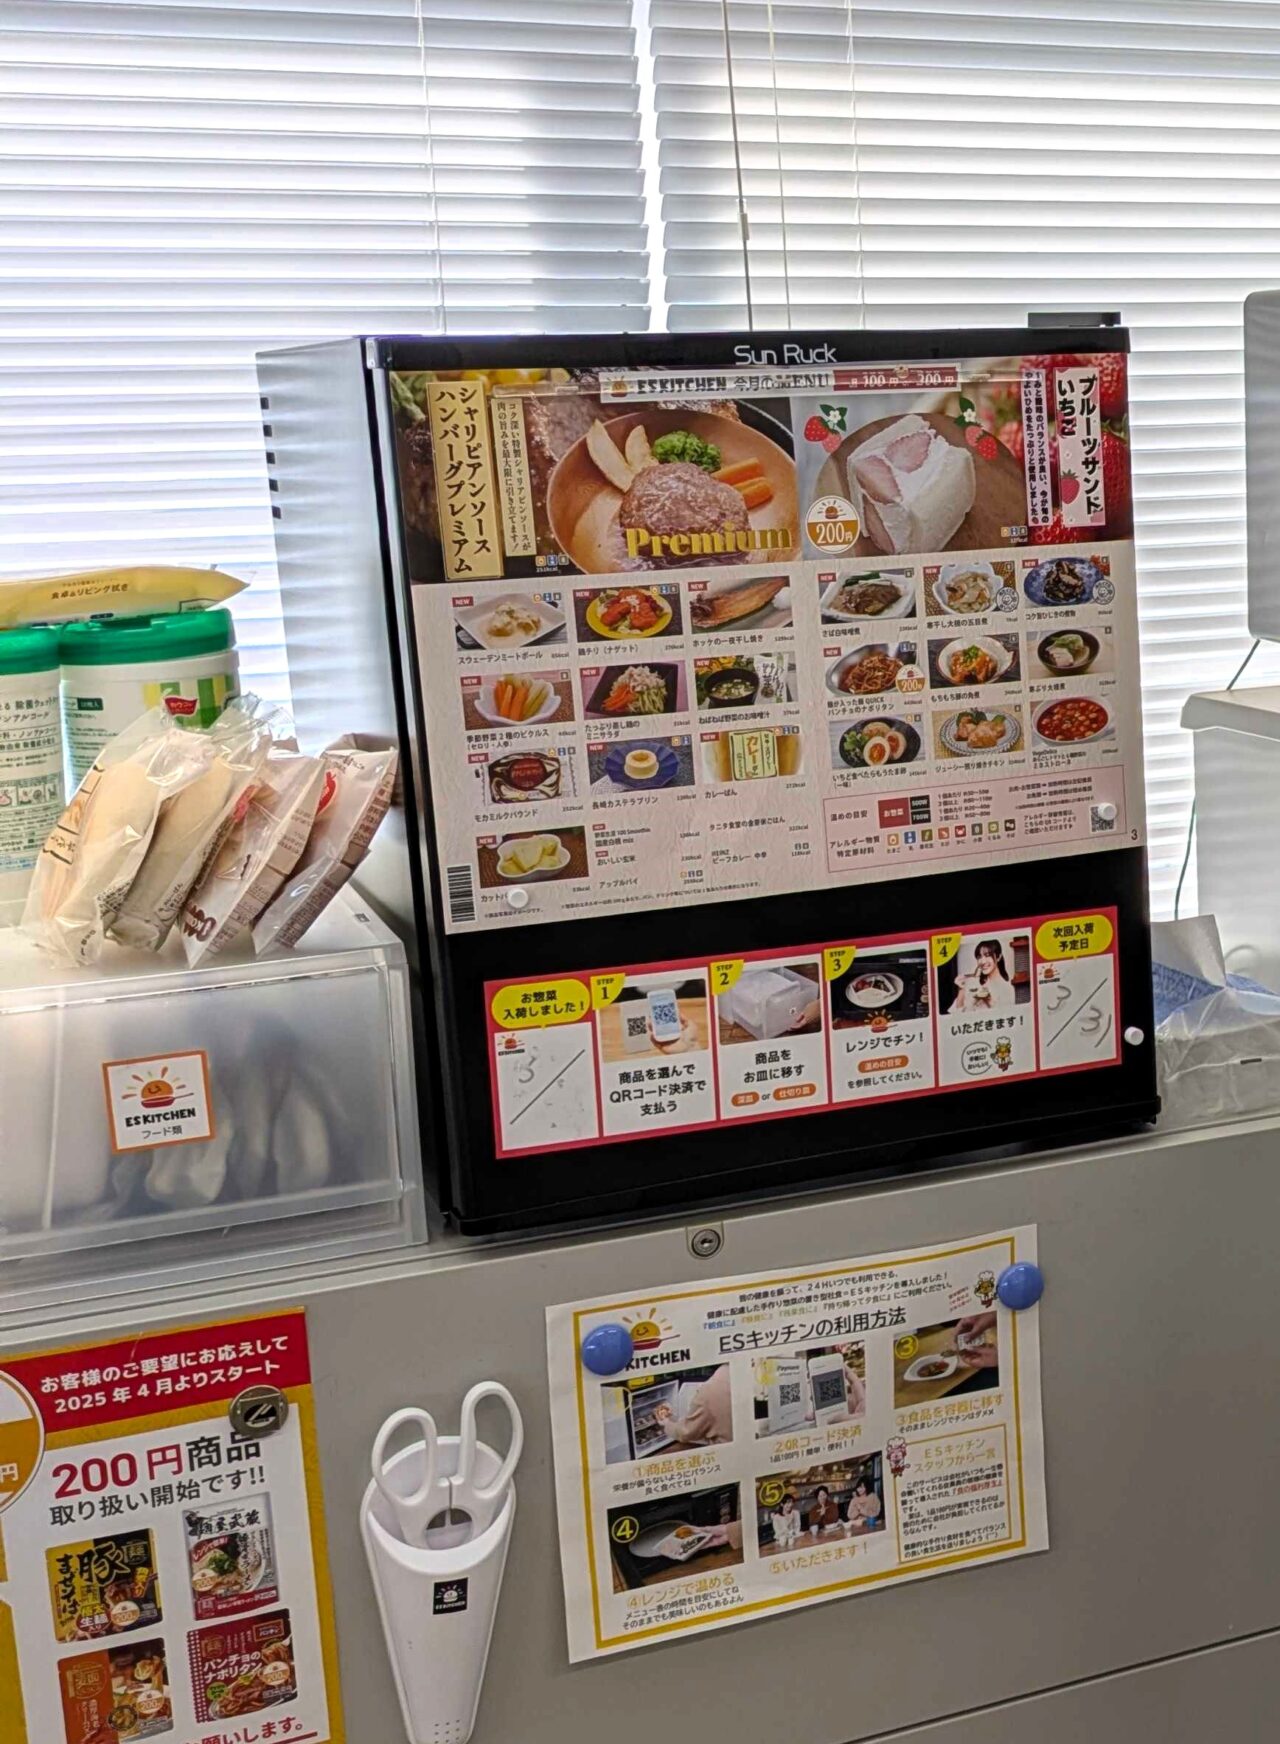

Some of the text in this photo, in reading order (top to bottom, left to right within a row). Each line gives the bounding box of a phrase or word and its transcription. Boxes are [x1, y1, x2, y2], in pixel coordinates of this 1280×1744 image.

[734, 343, 838, 364] Sun Ruck
[1058, 380, 1076, 437] いちご
[436, 391, 473, 573] ハンバーグプレミアム
[626, 521, 792, 558] Premium
[816, 522, 852, 544] 200円
[458, 651, 543, 664] スウェーデンミートボール
[475, 809, 538, 822] モカミルクパウンド
[1131, 829, 1138, 840] 3
[1053, 923, 1094, 937] 次回入荷
[939, 946, 948, 957] 4
[1058, 938, 1088, 952] 予定日
[833, 959, 841, 971] 3
[597, 978, 614, 986] STEP
[720, 973, 729, 986] 2
[521, 990, 557, 1004] お惣菜
[601, 987, 609, 999] 1
[503, 1002, 585, 1020] 入荷しました！
[951, 1016, 1024, 1036] いただきます！
[846, 1032, 924, 1053] レンジでチン！
[755, 1049, 791, 1065] 商品を
[865, 1059, 902, 1071] 温めの目安
[619, 1064, 695, 1085] 商品を選んで
[744, 1065, 804, 1084] お皿に移す
[848, 1072, 922, 1089] を参照してください。
[610, 1080, 706, 1102] QRコード決済で
[762, 1093, 770, 1101] or
[640, 1101, 677, 1116] 支払う
[142, 1125, 182, 1139] フード類
[719, 1306, 907, 1352] ESキッチンの利用方法
[40, 1336, 289, 1394] お客様のご要望にお応えして
[625, 1349, 691, 1371] KITCHEN
[52, 1430, 260, 1499] 200円商品
[56, 1554, 79, 1614] まぜそば
[204, 1651, 261, 1671] パンチョの
[205, 1662, 262, 1683] ナポリタン
